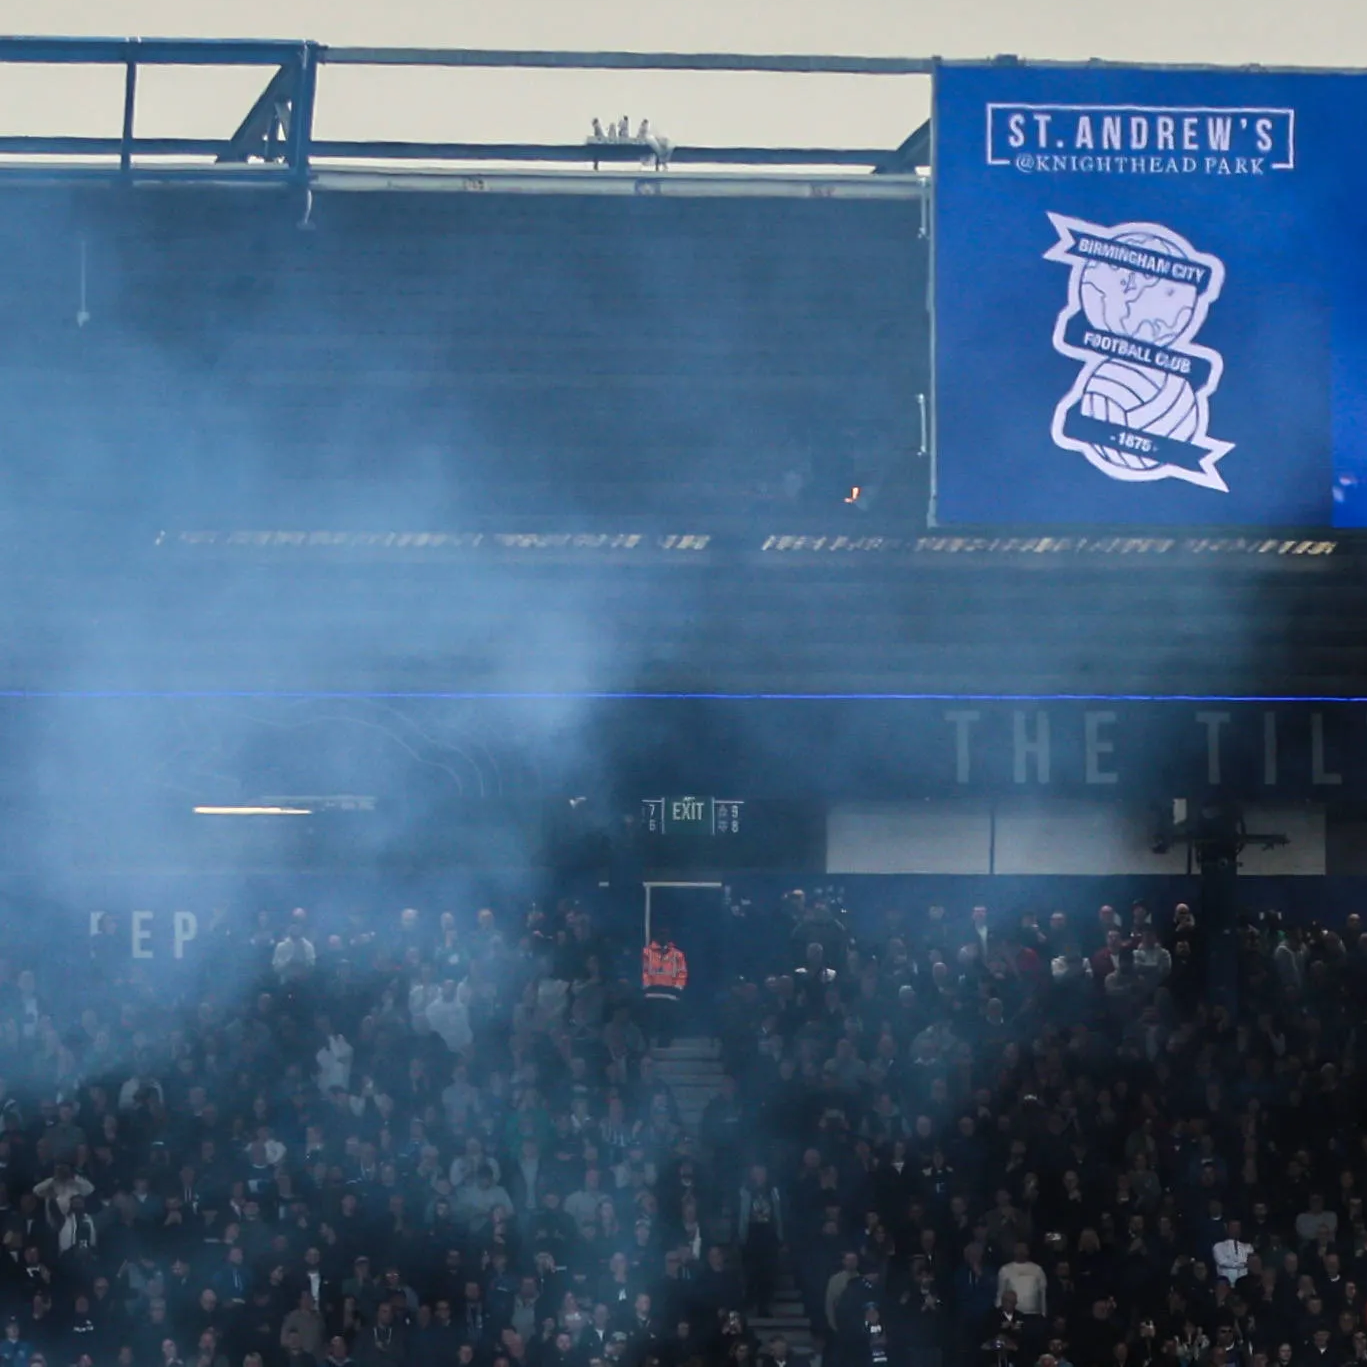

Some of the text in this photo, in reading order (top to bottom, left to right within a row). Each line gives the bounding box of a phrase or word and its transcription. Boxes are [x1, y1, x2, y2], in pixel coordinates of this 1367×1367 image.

[1016, 153, 1265, 176] @KNIGHTHEAD PARK
[1078, 238, 1206, 283] BIRMINGHAM CITY
[1083, 332, 1193, 375] FOOTBALL CLUB
[944, 711, 1119, 784] THE
[672, 802, 704, 820] EXIT
